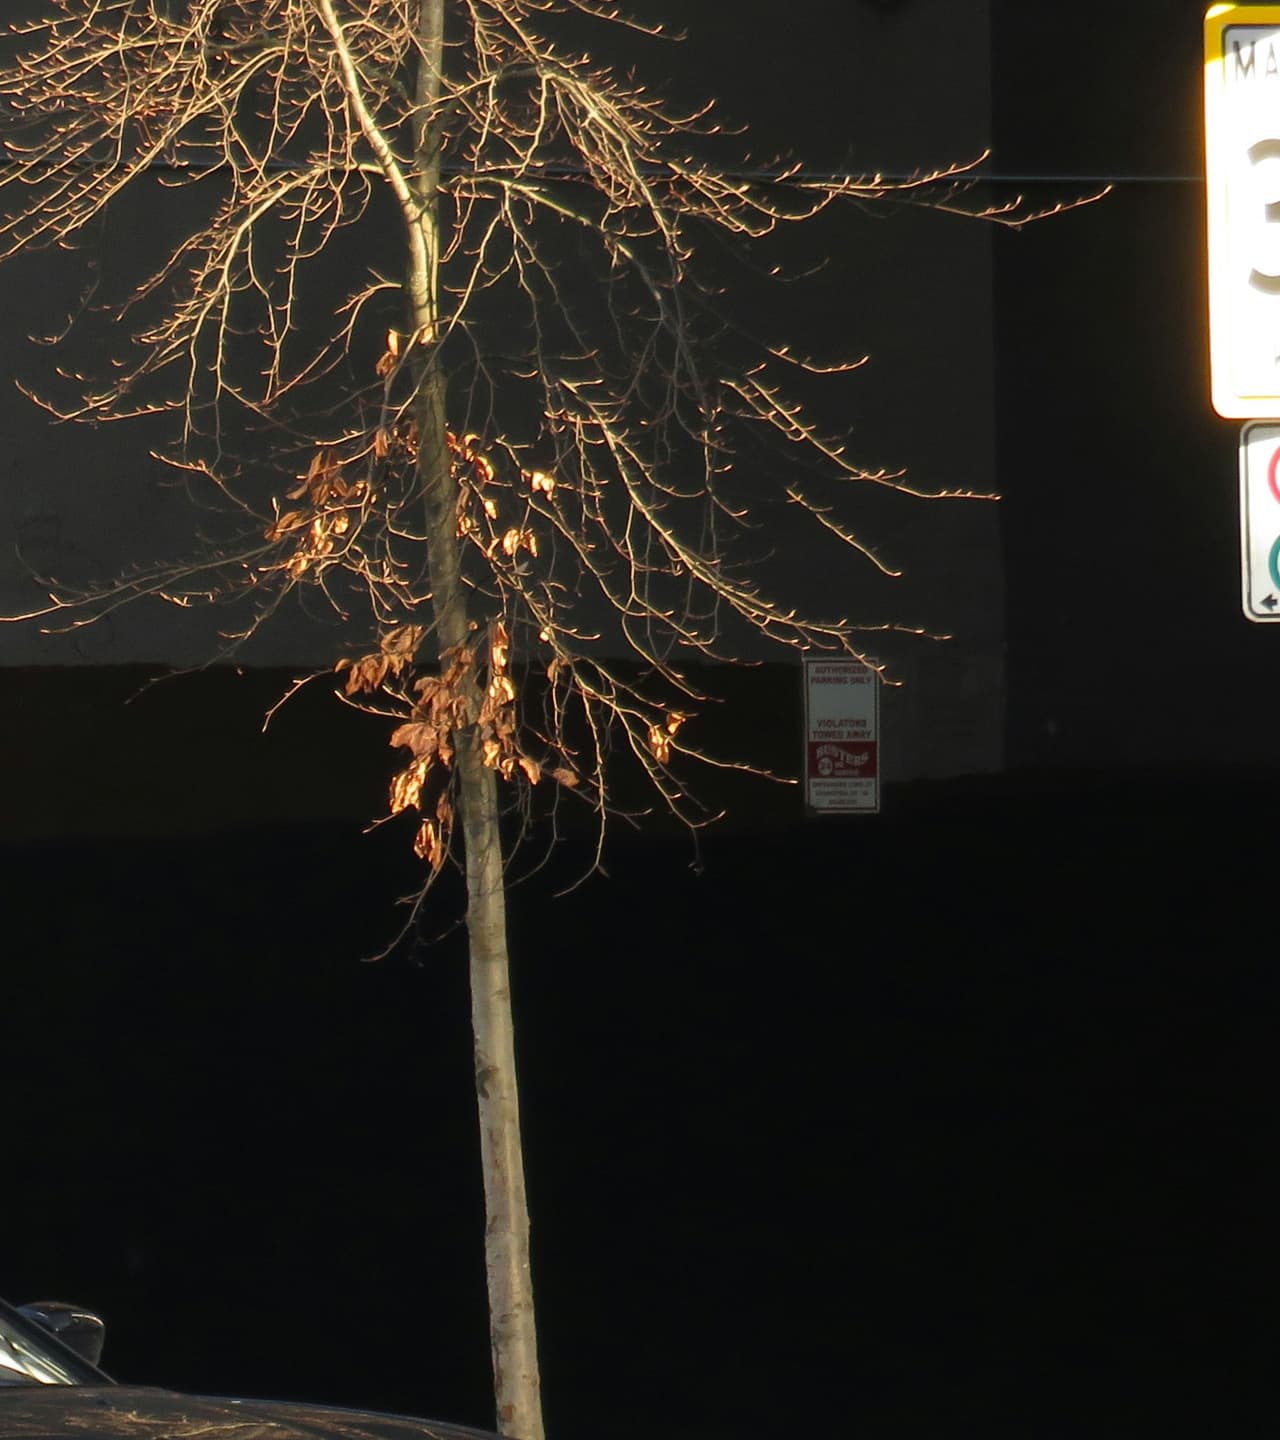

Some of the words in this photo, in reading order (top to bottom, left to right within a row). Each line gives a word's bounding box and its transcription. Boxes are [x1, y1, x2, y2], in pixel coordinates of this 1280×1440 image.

[816, 718, 868, 729] VIOLATORS
[811, 730, 844, 740] TOWED
[846, 730, 872, 740] AWAY
